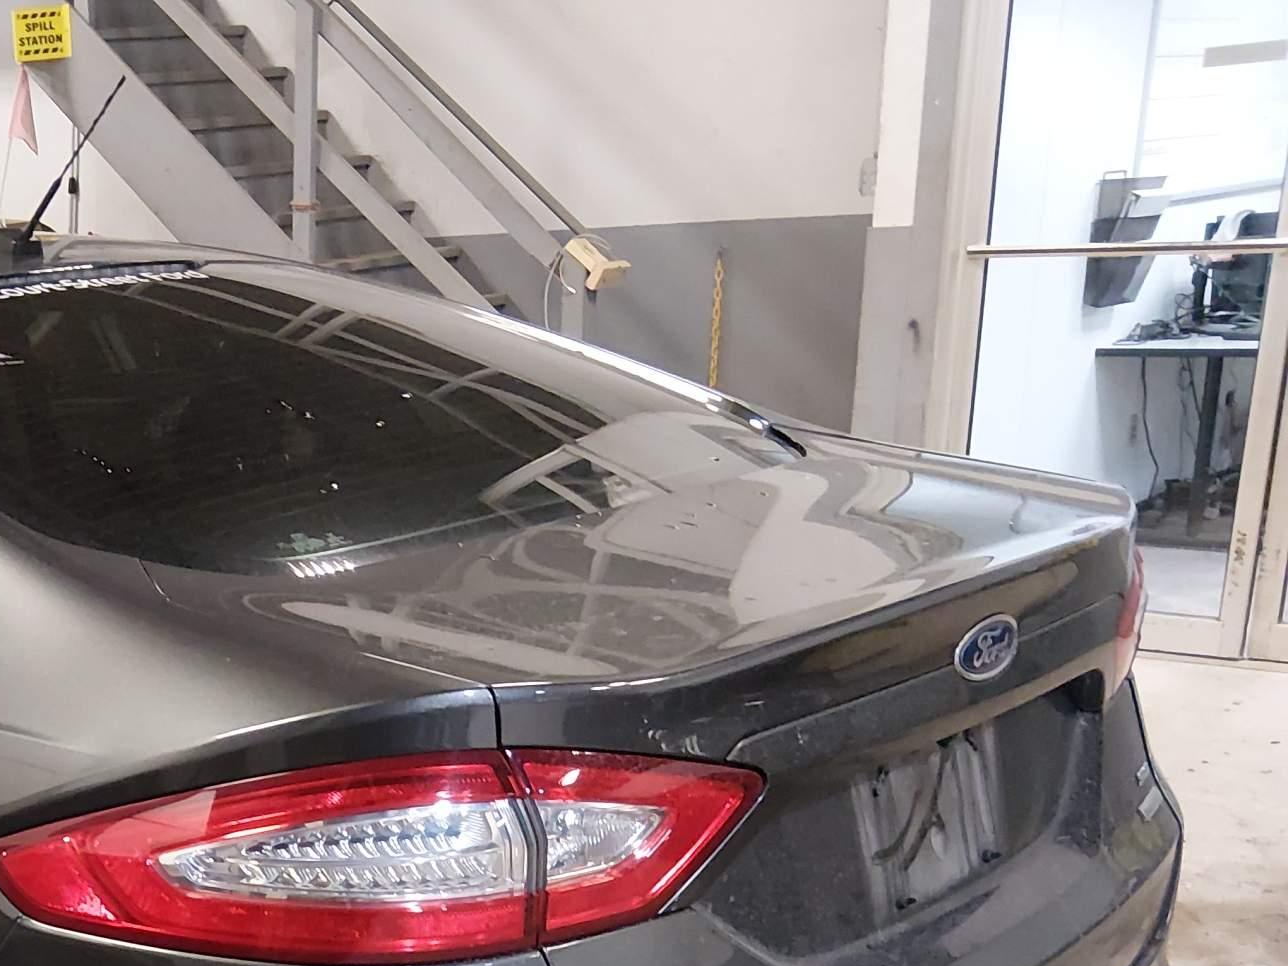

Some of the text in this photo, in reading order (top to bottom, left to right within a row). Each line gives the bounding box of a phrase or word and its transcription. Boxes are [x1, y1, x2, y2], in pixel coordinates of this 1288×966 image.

[25, 21, 55, 32] SPILL
[18, 34, 63, 47] STATION
[139, 269, 209, 281] Ford
